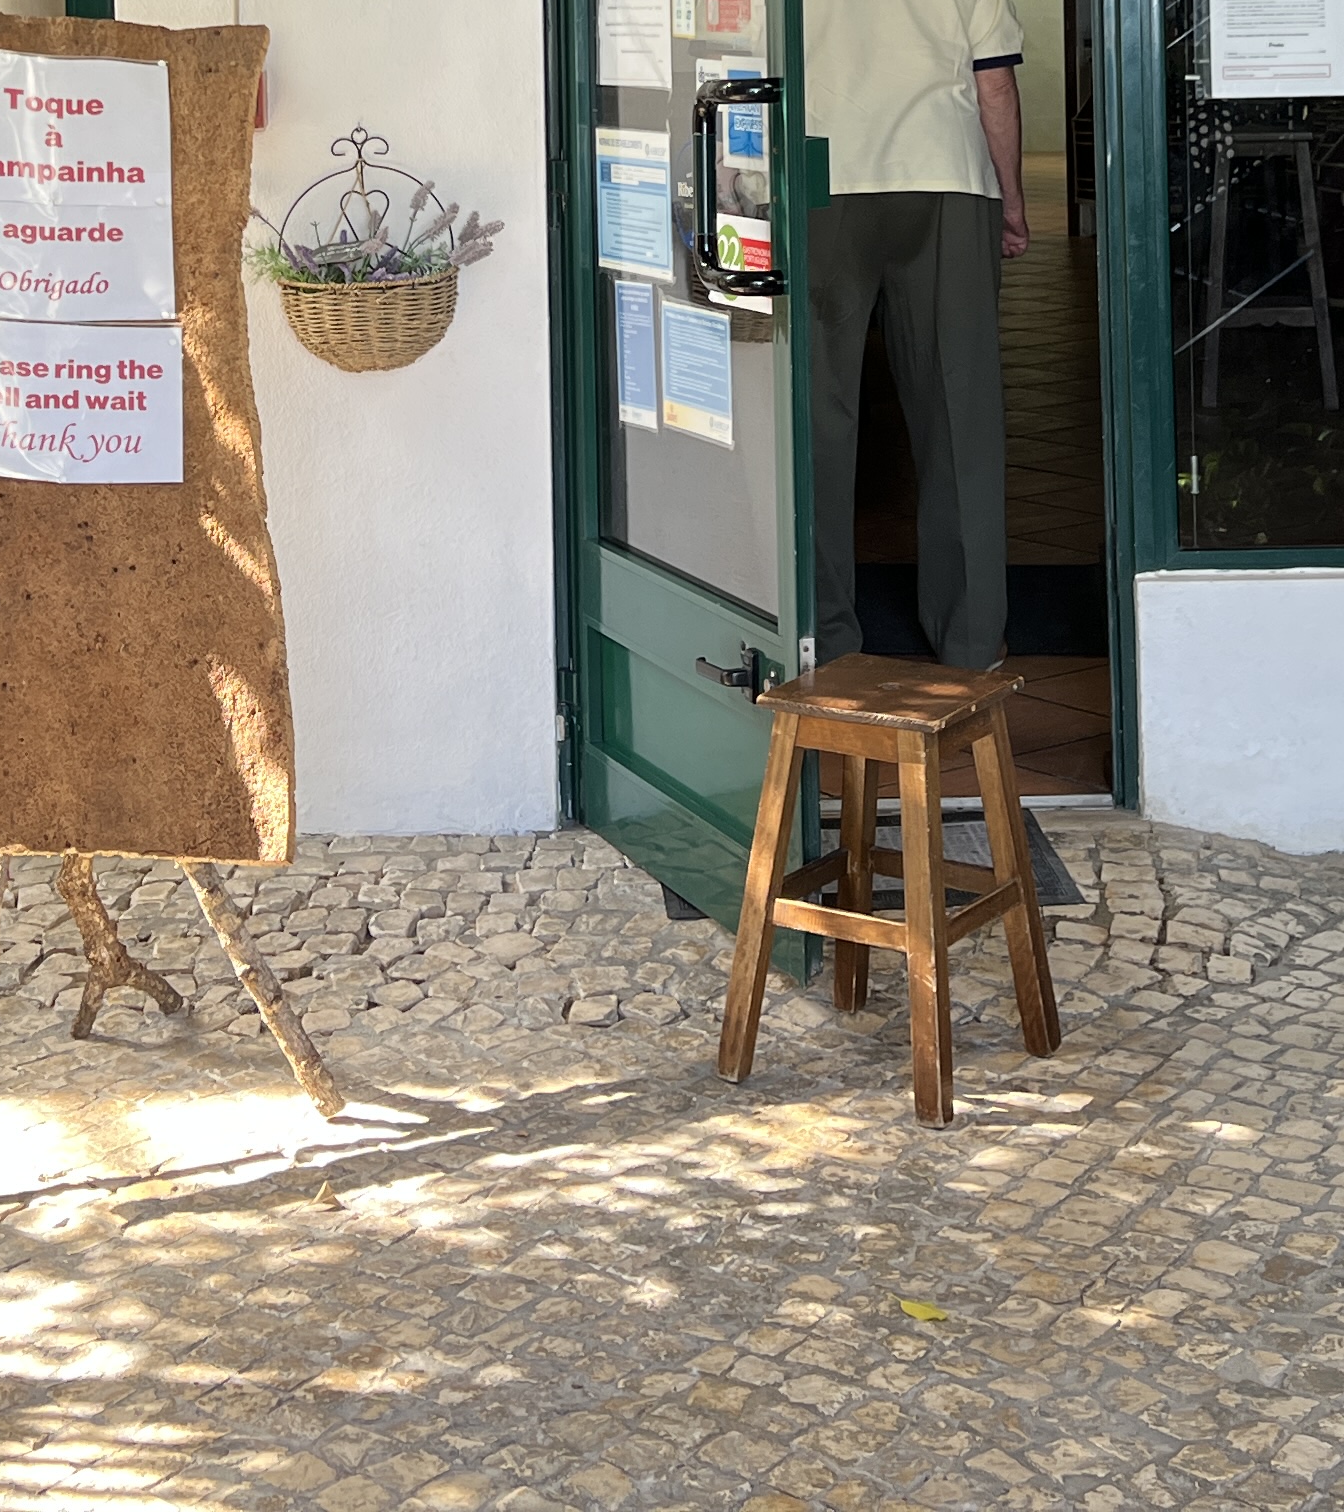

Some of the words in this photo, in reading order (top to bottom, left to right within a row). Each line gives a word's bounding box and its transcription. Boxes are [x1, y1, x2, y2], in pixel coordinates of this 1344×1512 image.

[3, 87, 104, 118] Toque
[44, 124, 64, 148] à
[2, 217, 124, 244] aguarde
[54, 358, 111, 384] ring
[117, 359, 163, 380] the
[25, 388, 80, 410] and
[85, 388, 148, 412] wait
[83, 433, 142, 462] you
